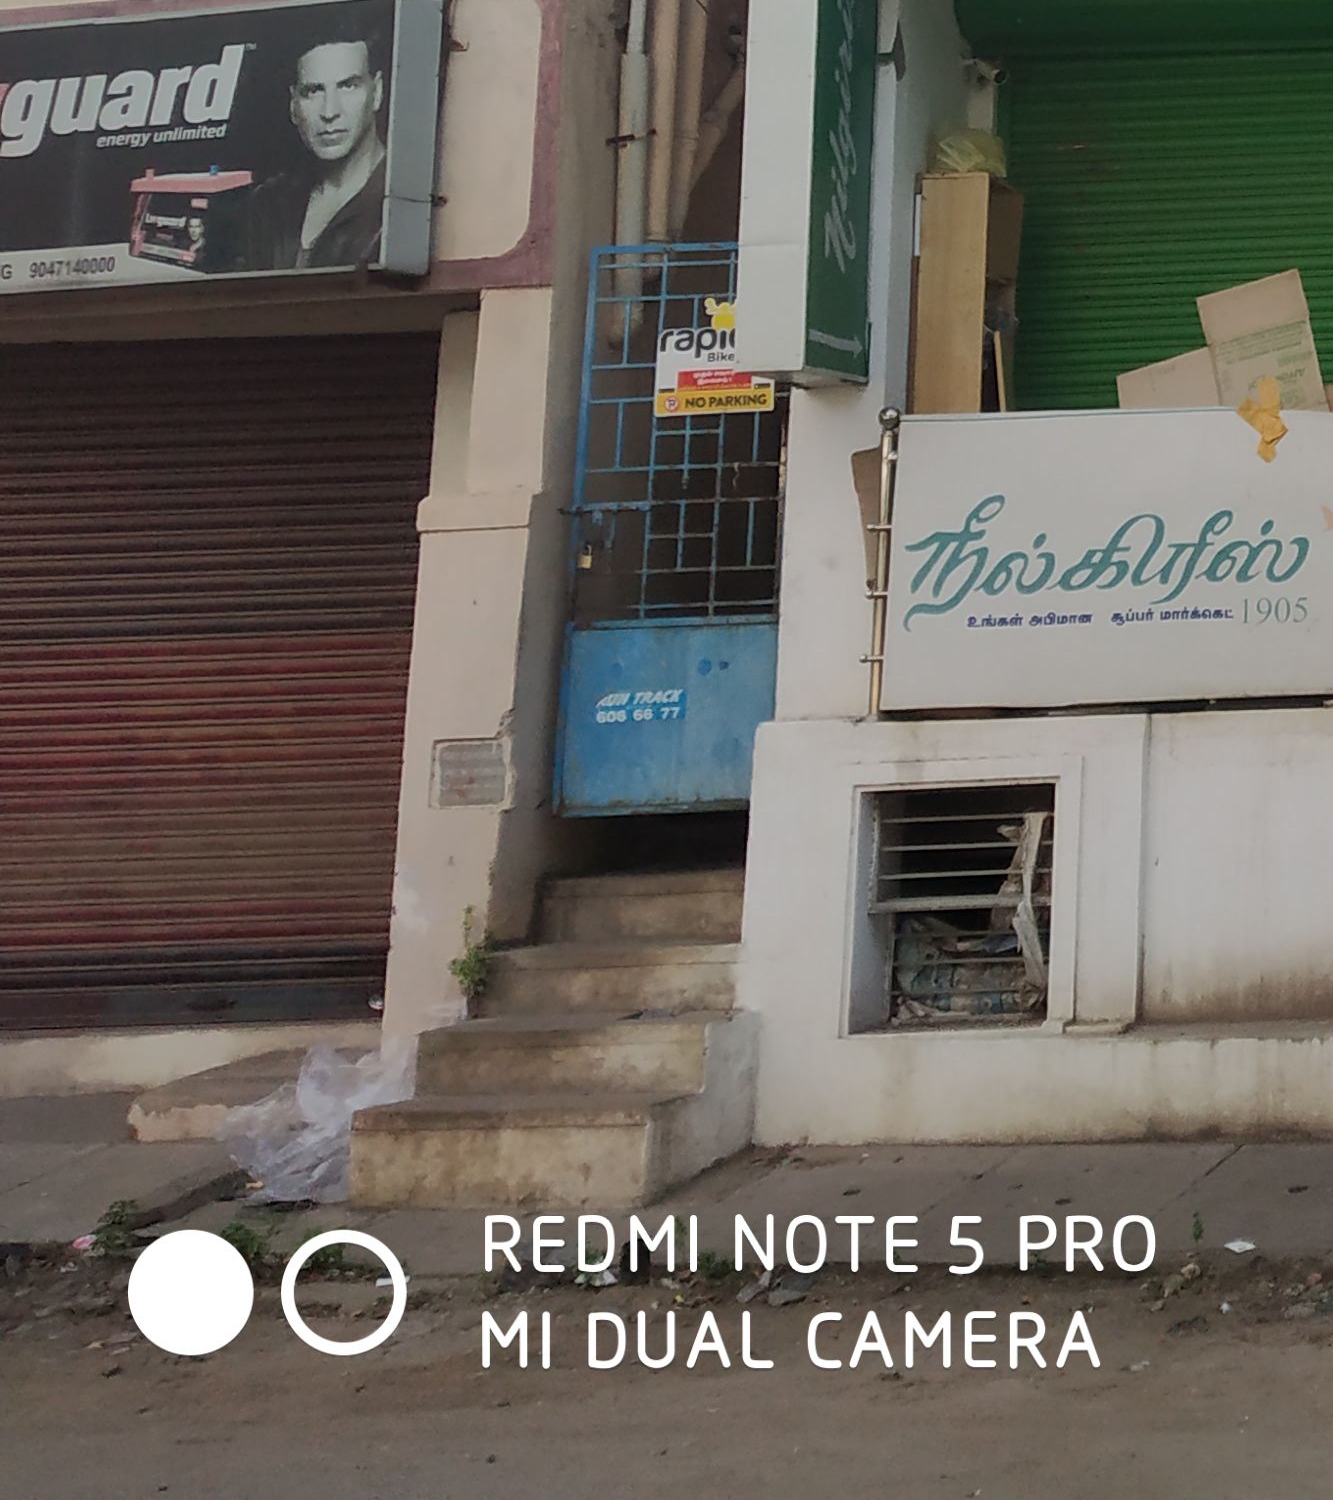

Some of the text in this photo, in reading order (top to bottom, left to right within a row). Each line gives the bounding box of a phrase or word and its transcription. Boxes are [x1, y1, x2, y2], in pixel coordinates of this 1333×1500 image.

[0, 44, 246, 158] guard
[96, 122, 228, 149] energy unlimited
[707, 352, 735, 363] Bike
[685, 393, 767, 409] NO PARKING
[904, 495, 1310, 632] நீல்கிரீஸ்
[967, 612, 1023, 628] உங்கள்
[1029, 611, 1093, 627] அபிமான
[1243, 597, 1308, 624] 1905
